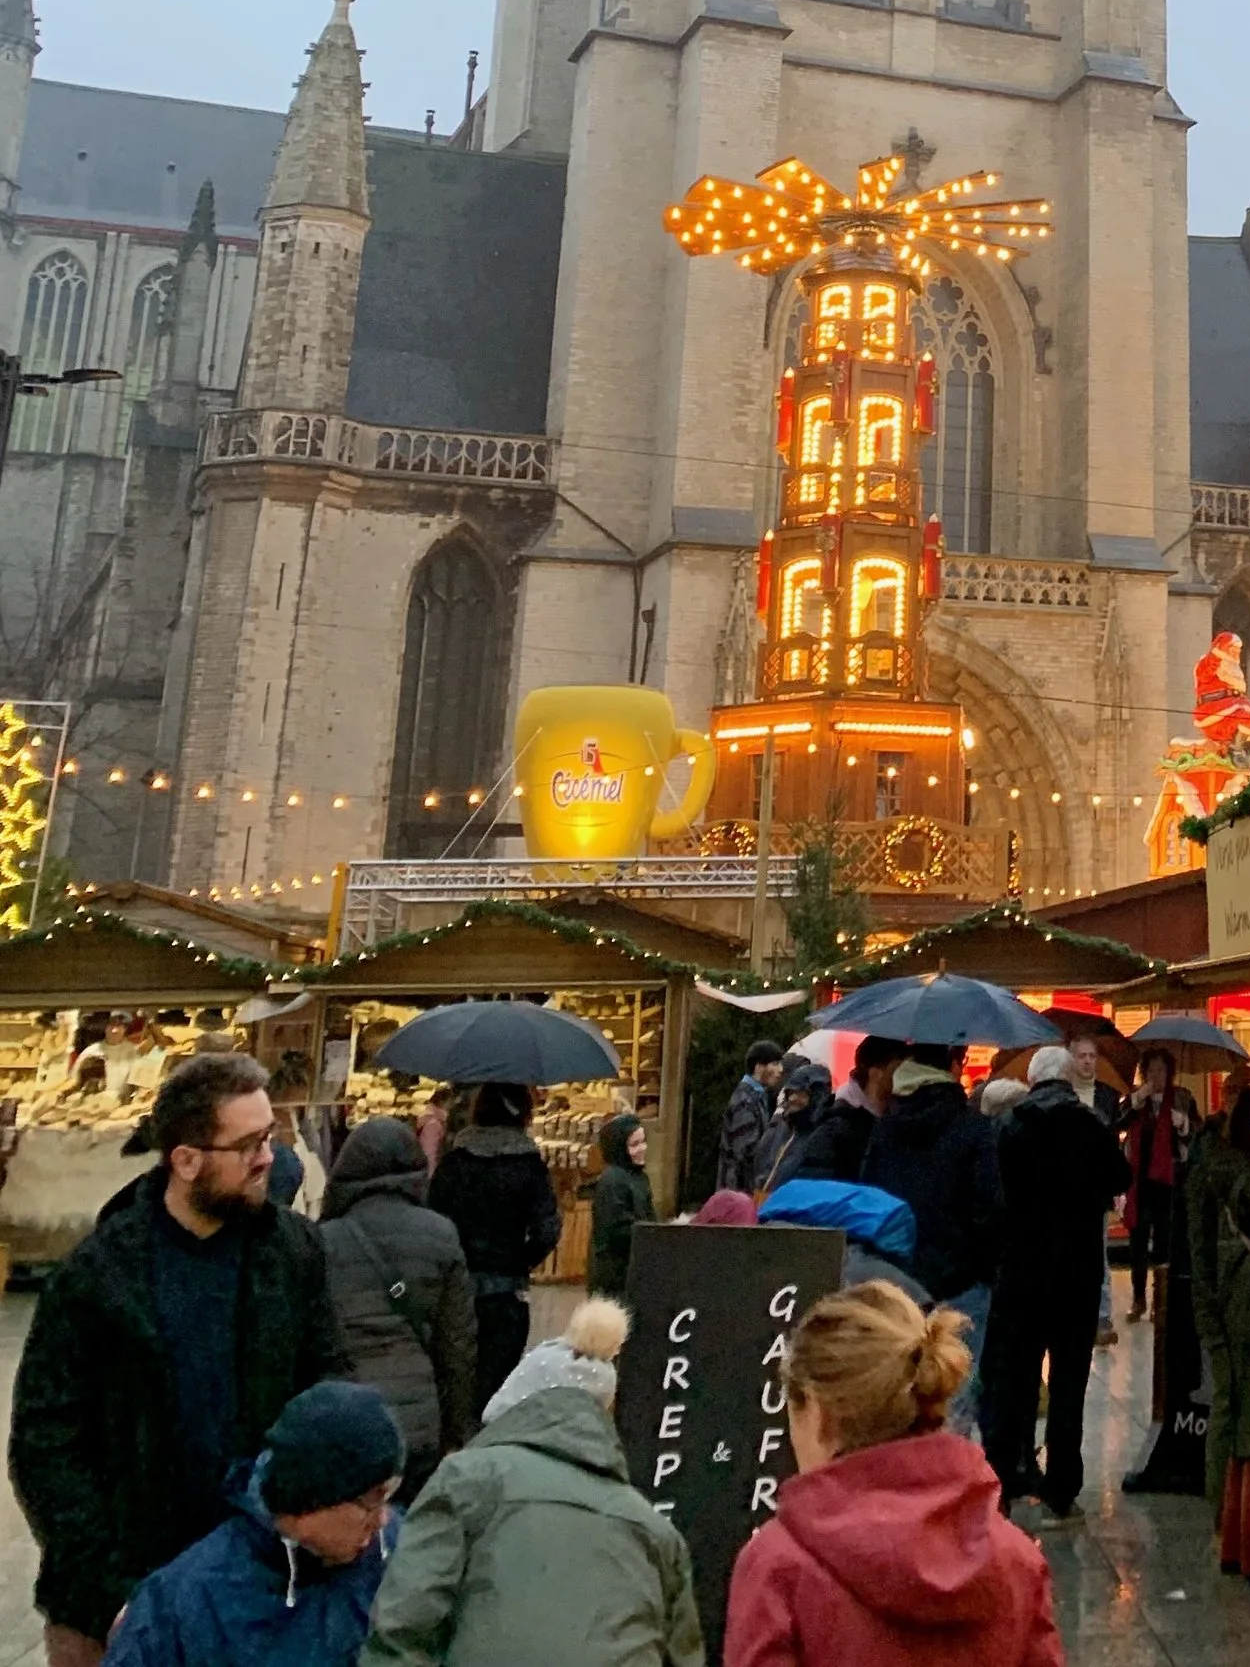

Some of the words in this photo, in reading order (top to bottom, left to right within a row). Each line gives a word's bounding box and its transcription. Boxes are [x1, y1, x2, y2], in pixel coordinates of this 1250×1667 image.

[652, 1307, 697, 1521] CREP
[711, 1441, 732, 1463] &
[750, 1284, 798, 1534] GAUFR
